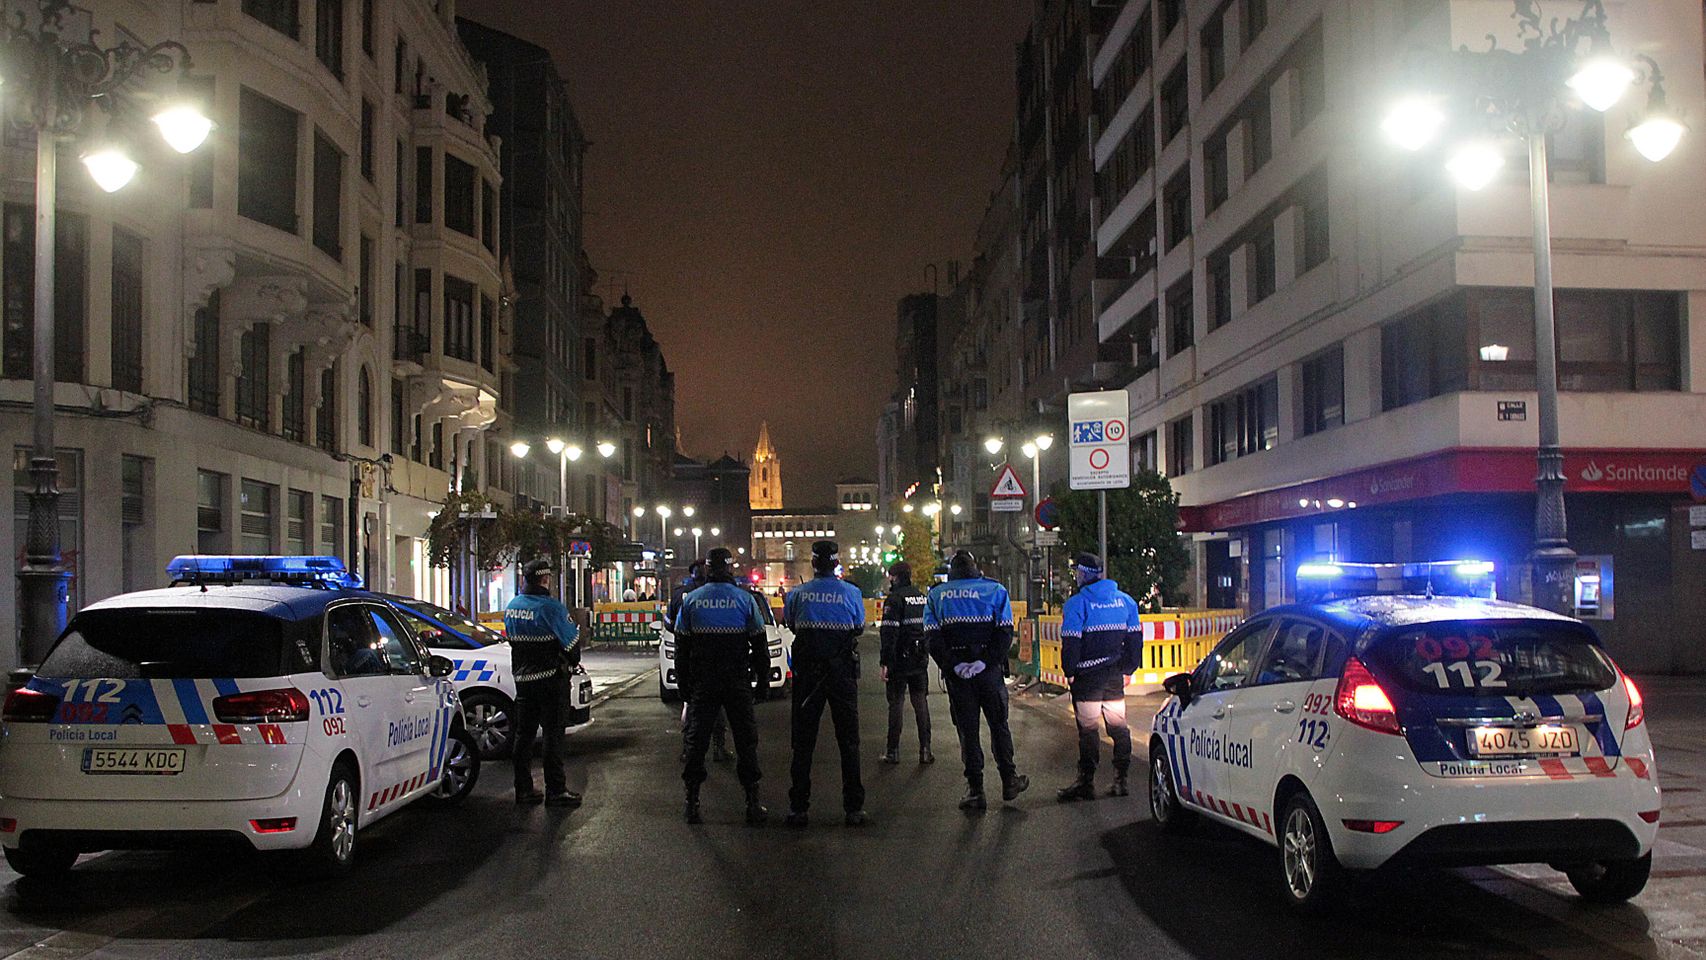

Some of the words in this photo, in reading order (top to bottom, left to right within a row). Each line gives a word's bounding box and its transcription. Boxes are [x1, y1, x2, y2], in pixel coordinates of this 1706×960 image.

[1110, 427, 1120, 435] 10
[1605, 464, 1688, 481] Santande
[802, 592, 844, 604] POLICÍA
[940, 587, 980, 600] POLICÍA
[695, 598, 737, 609] POLICÍA
[506, 608, 534, 621] POLICÍA
[1415, 637, 1499, 660] 092
[1422, 661, 1507, 689] 112
[61, 678, 126, 703] 112
[310, 688, 345, 716] 112
[1304, 693, 1332, 716] 092
[61, 703, 109, 723] 092
[88, 729, 117, 741] Local
[323, 717, 346, 737] 092
[388, 716, 413, 748] Policía
[414, 712, 431, 739] Local
[1298, 718, 1329, 750] 112
[1189, 727, 1221, 762] Policía
[1223, 733, 1253, 769] Local
[1482, 731, 1531, 749] 4045
[1538, 730, 1573, 749] JZD
[96, 751, 139, 768] 5544
[144, 751, 179, 769] KDC
[1489, 762, 1522, 775] Local
